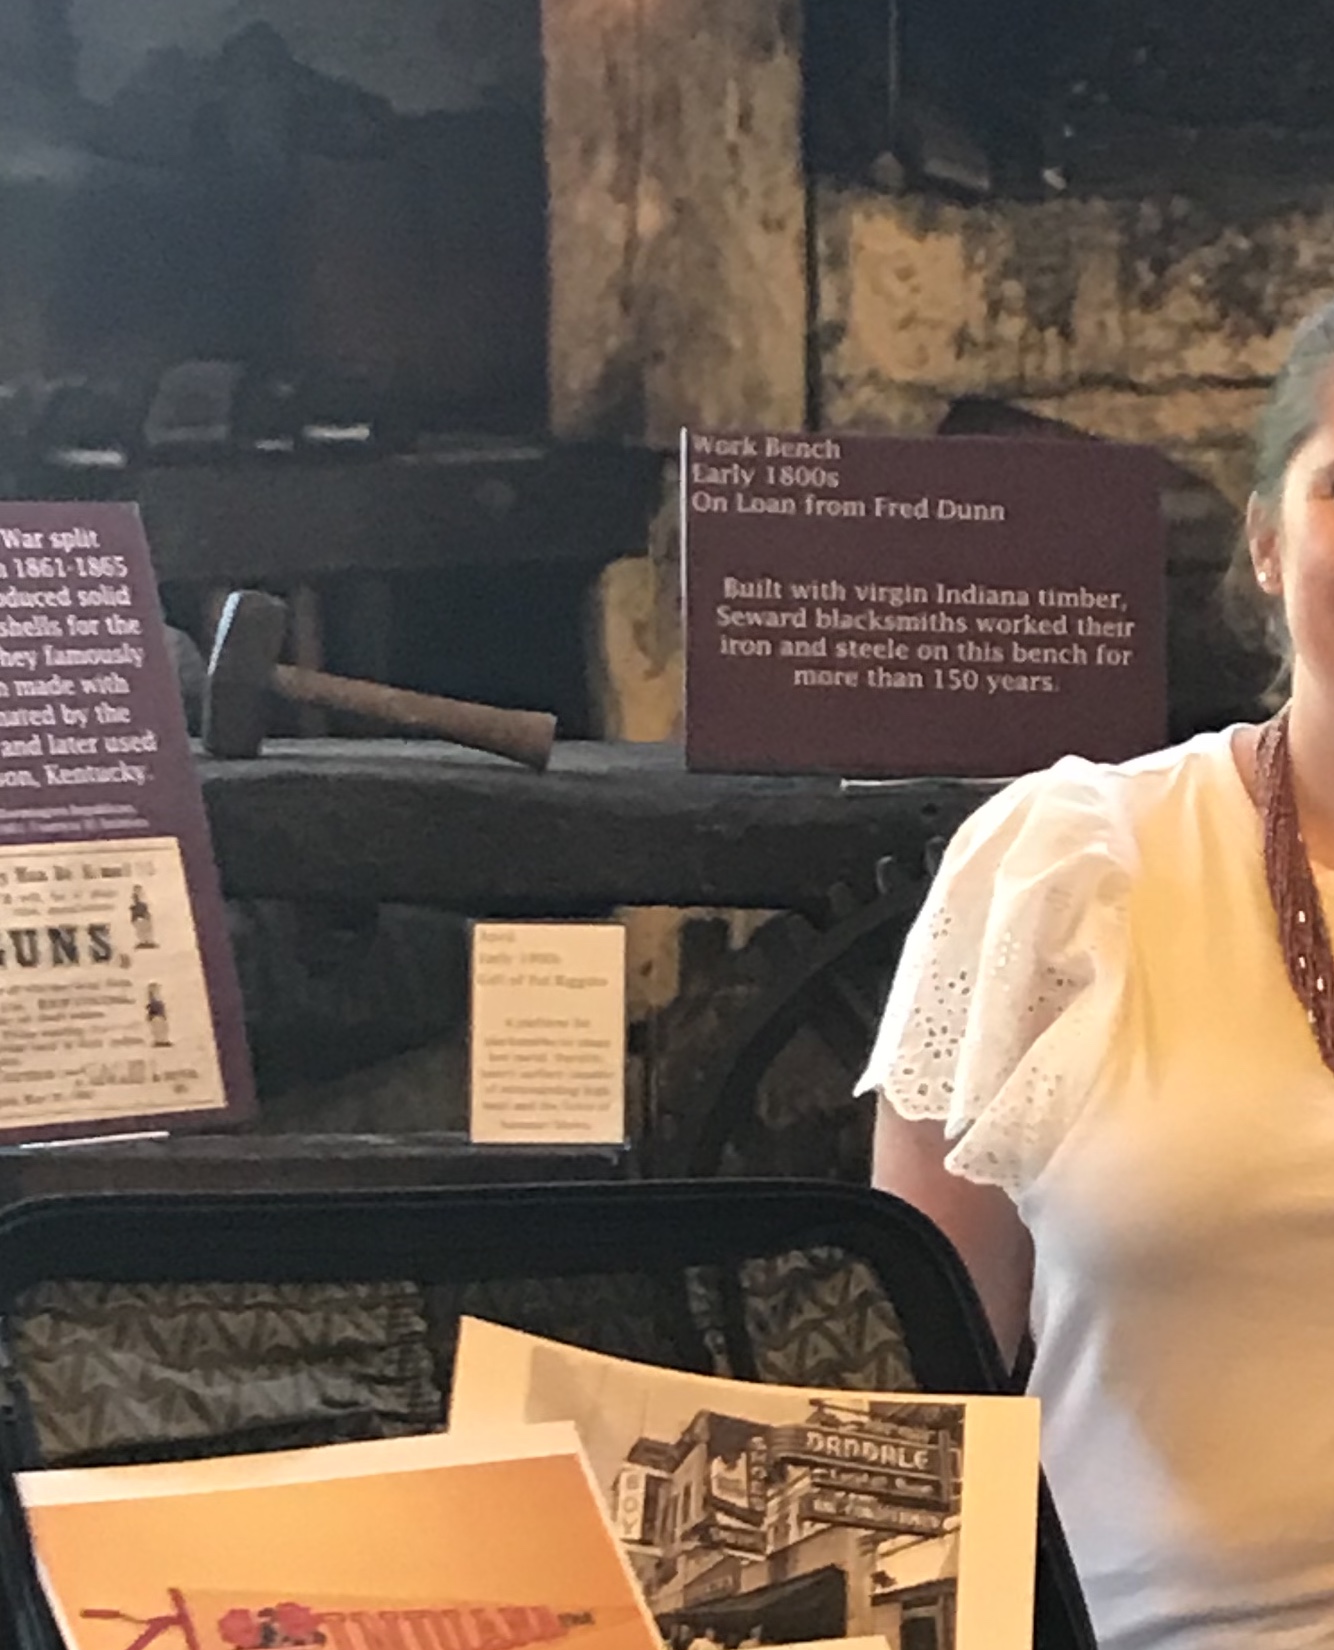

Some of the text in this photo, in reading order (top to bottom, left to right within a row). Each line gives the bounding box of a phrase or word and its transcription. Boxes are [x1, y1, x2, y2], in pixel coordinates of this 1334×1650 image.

[691, 434, 842, 459] Work Bench
[691, 463, 840, 488] Early 1800s
[691, 490, 1006, 521] On Loan from Fred Dunn
[0, 527, 101, 553] War split
[12, 556, 129, 579] 1861-1865
[76, 583, 132, 608] solid
[723, 576, 1129, 613] Built with virgin Indiana timber,
[66, 614, 101, 637] for
[104, 613, 143, 636] the
[716, 604, 1136, 638] Seward blacksmiths worked their
[42, 642, 145, 669] famously
[719, 634, 1135, 667] iron and steele on this bench for
[13, 673, 76, 697] made
[79, 671, 131, 695] with
[793, 666, 1061, 696] more than 150 years.
[59, 702, 90, 729] by
[93, 700, 132, 724] the
[0, 729, 159, 758] and later used
